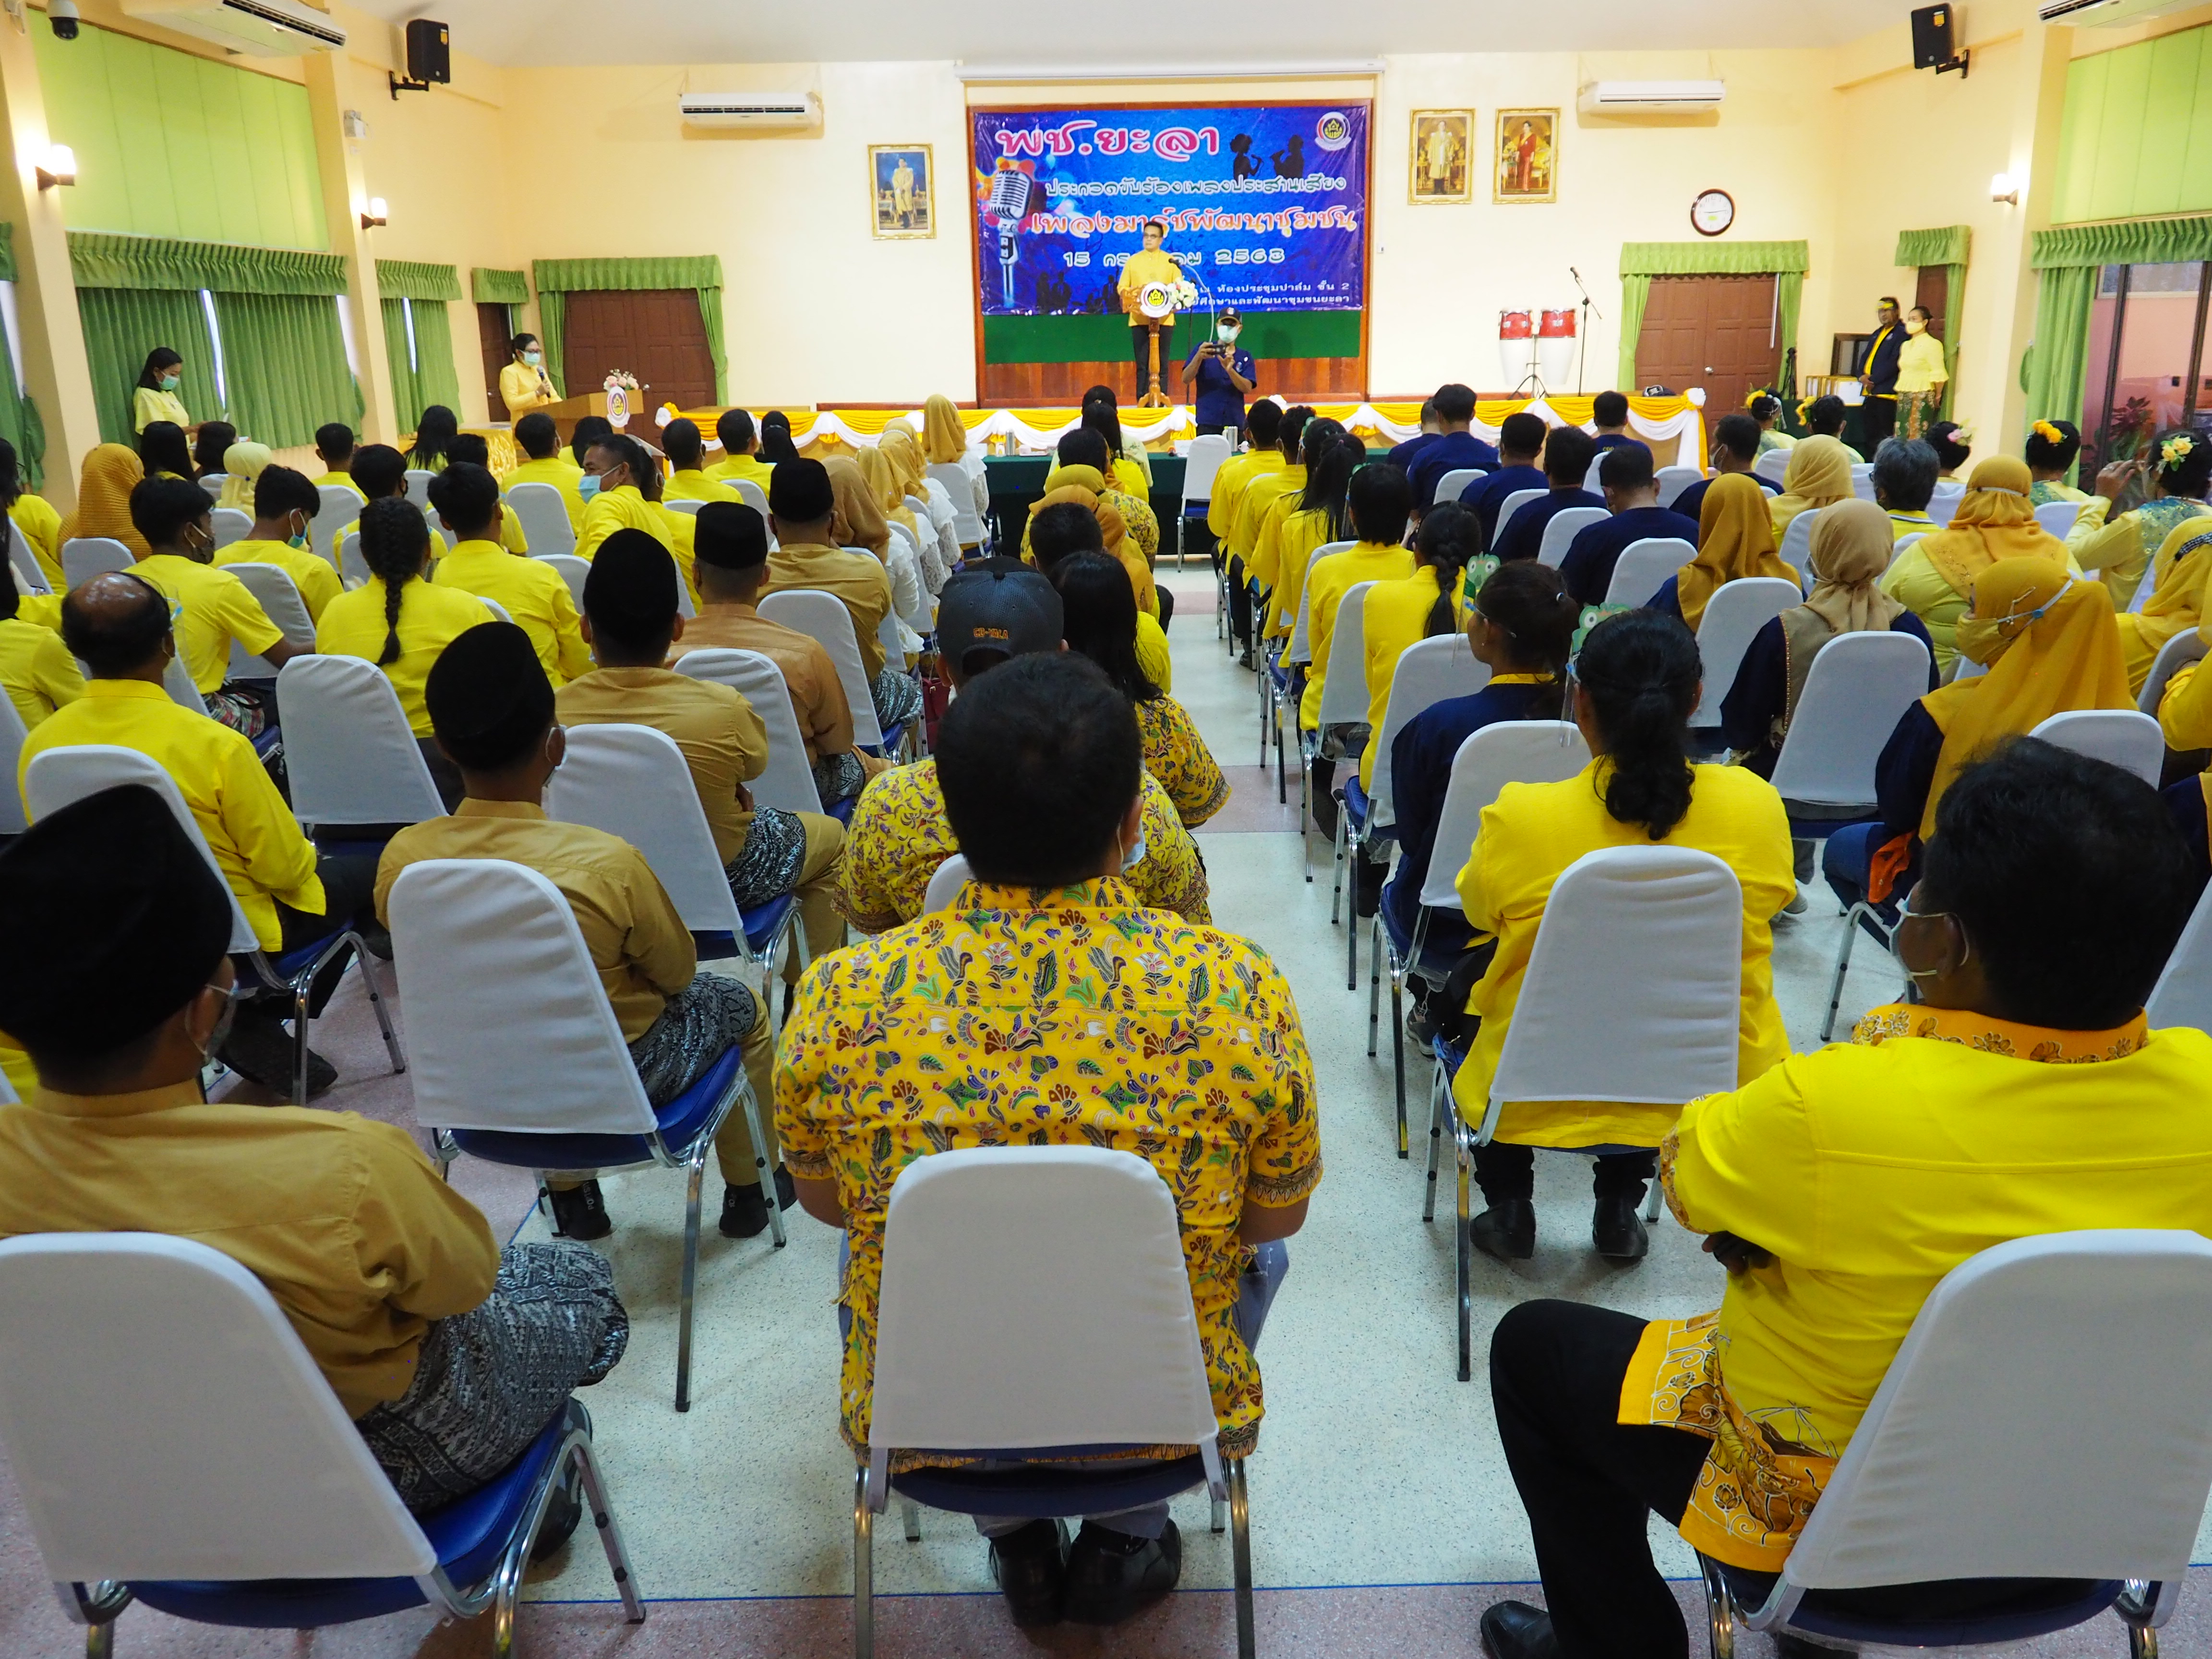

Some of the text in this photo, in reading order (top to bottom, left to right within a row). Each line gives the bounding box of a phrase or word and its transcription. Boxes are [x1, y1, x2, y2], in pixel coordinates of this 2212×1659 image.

[995, 120, 1219, 162] พช.ยะลา
[1063, 252, 1091, 267] 15
[1215, 248, 1285, 264] 2563
